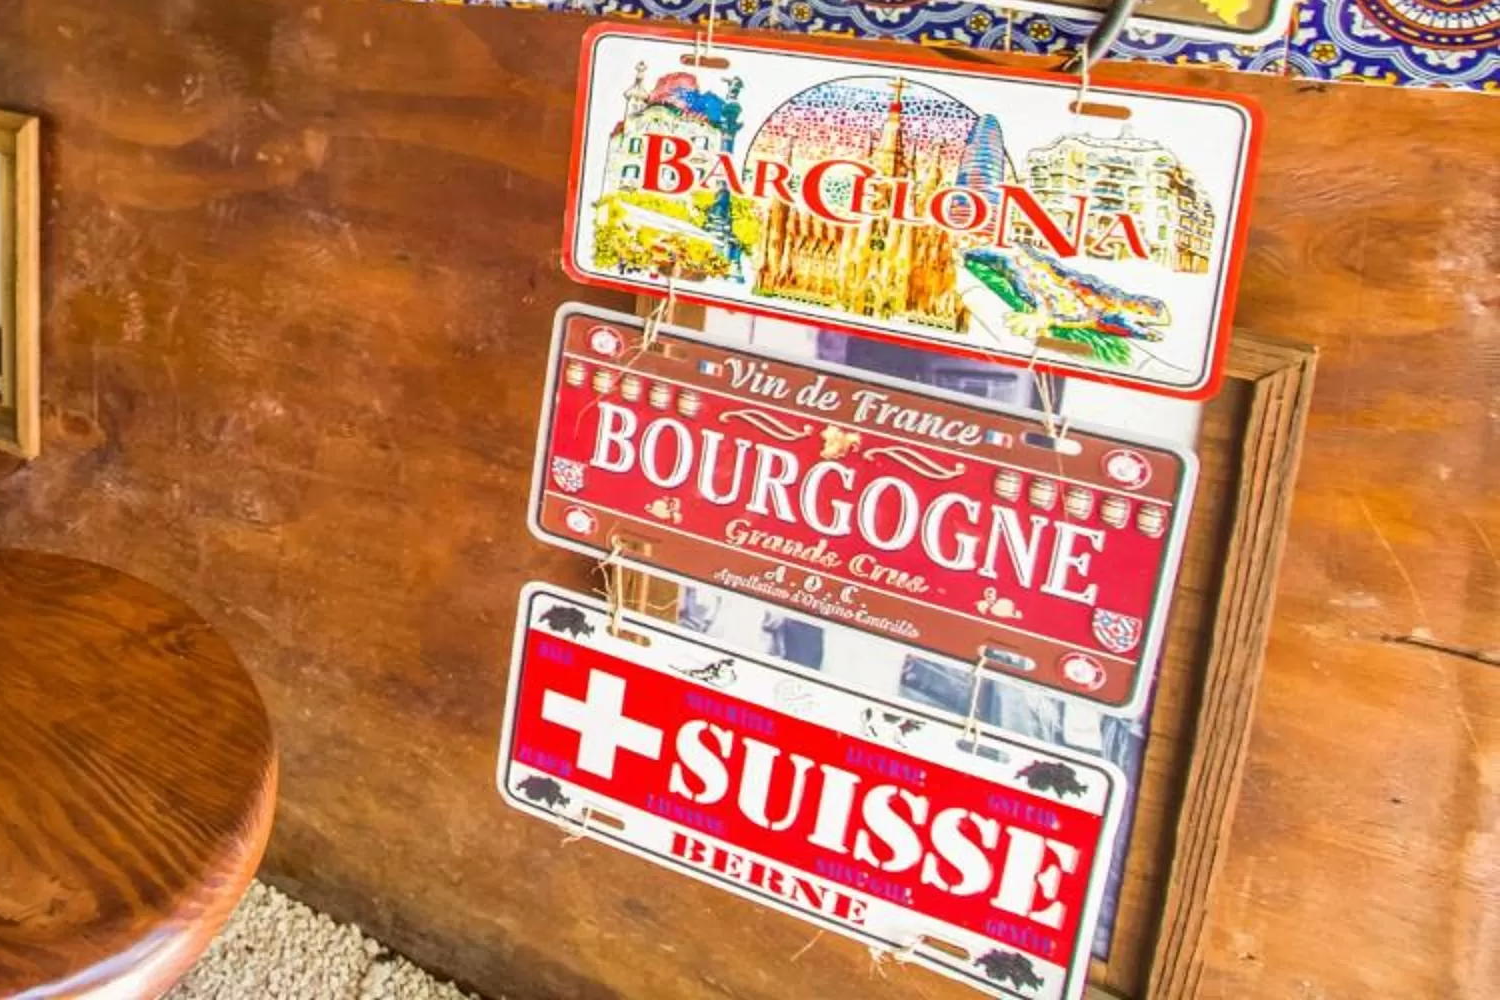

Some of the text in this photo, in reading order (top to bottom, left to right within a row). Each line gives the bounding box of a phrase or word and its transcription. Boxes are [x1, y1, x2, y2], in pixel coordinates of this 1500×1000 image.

[640, 132, 1150, 260] BARCELONA
[723, 357, 984, 447] Vin de France
[589, 400, 1106, 607] BOURGOGNE
[668, 718, 1081, 931] SUISSE
[670, 829, 869, 927] BERNE
